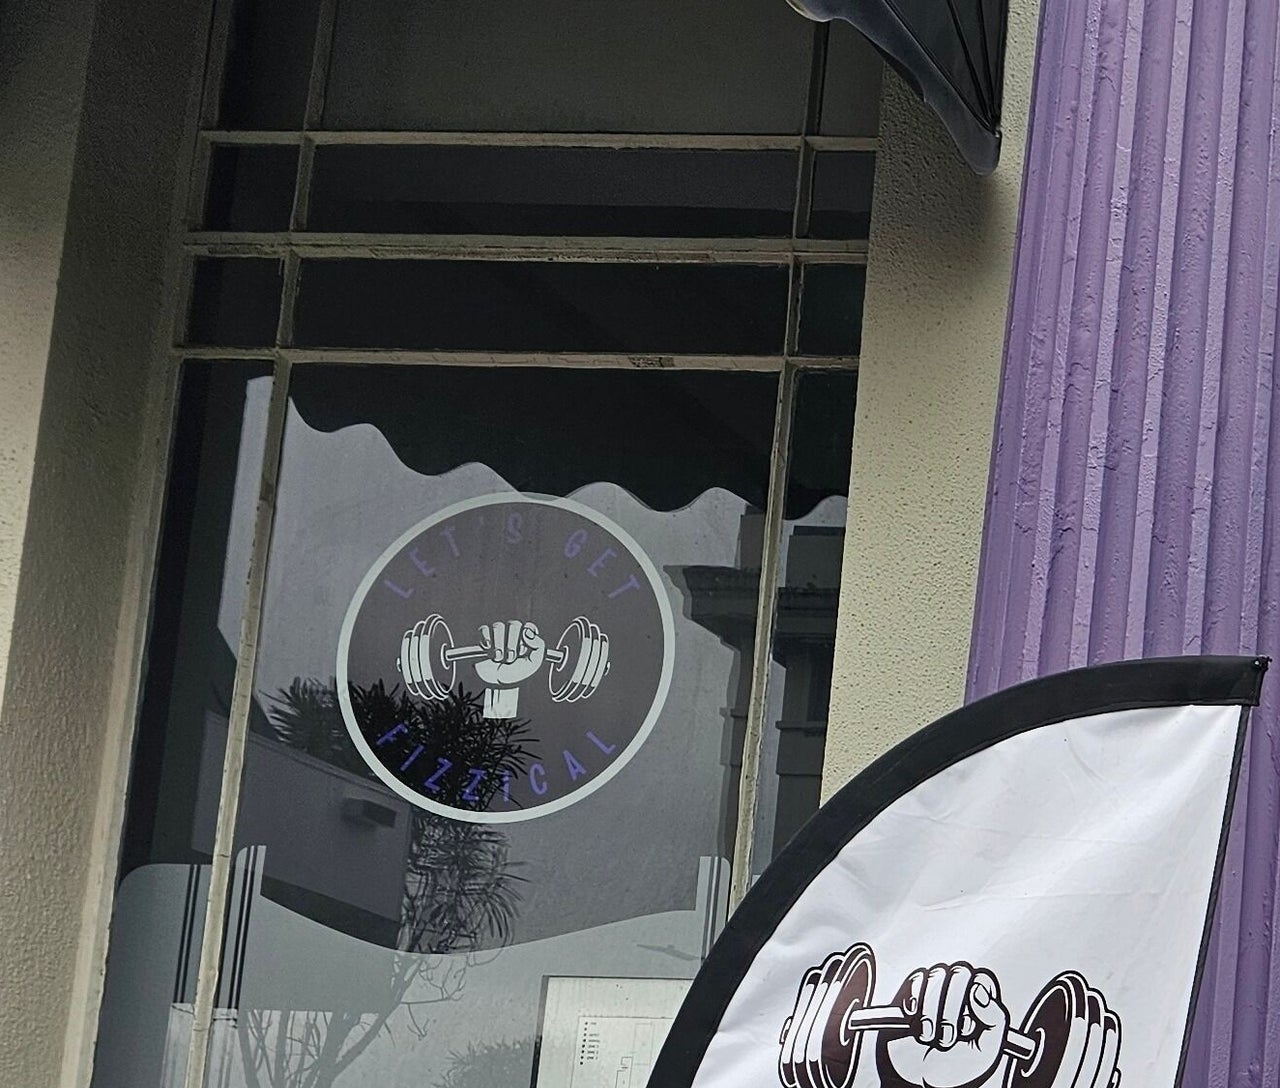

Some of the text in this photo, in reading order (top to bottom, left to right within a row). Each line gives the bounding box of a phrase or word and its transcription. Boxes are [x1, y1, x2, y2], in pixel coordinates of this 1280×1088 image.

[384, 513, 640, 598] LET'S GET
[376, 724, 616, 801] FIZZICAL
